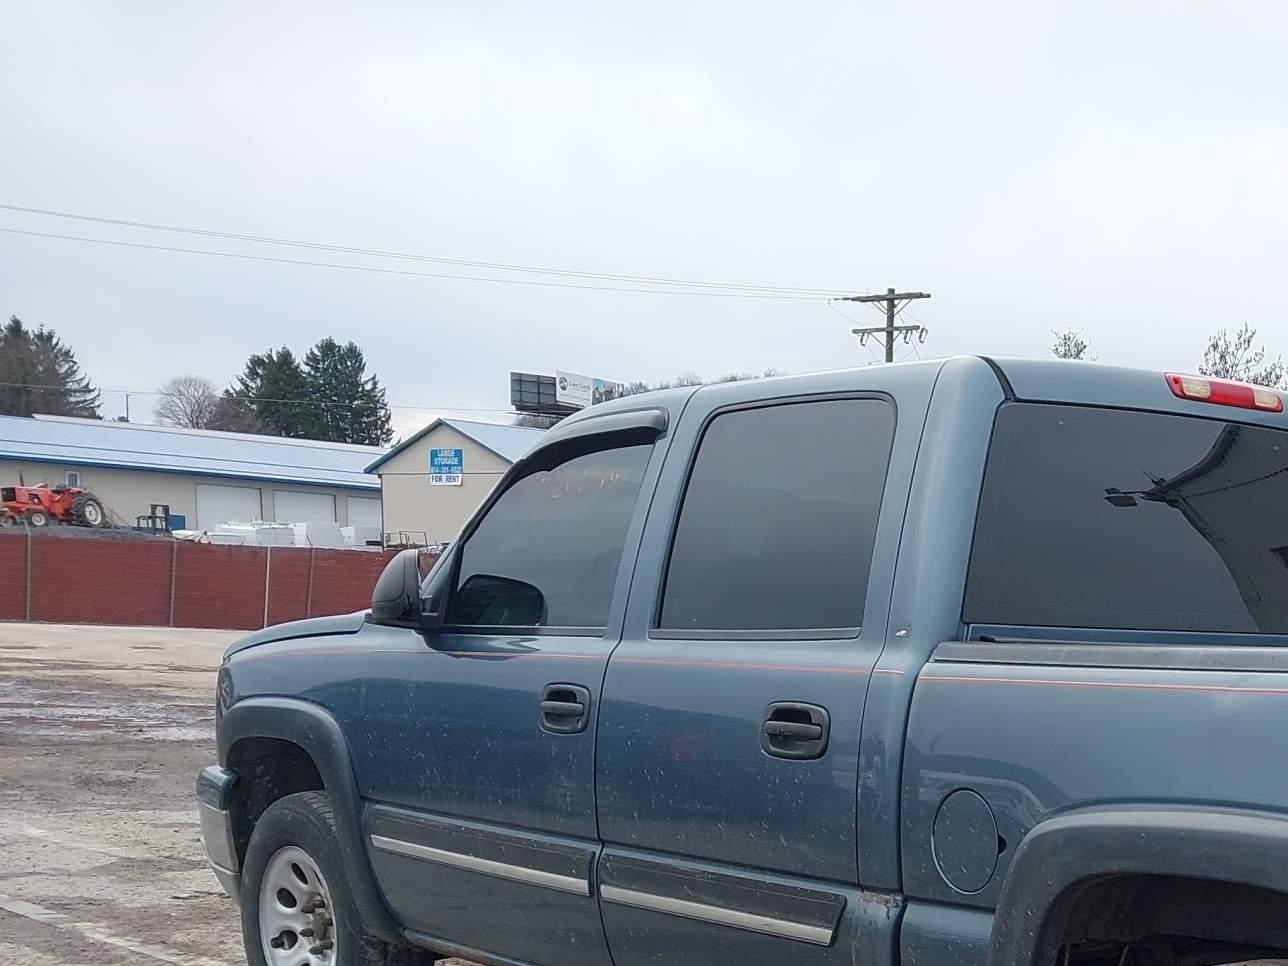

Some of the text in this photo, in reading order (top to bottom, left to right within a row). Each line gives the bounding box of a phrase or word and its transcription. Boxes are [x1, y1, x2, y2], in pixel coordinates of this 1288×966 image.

[437, 449, 455, 457] LARGE
[433, 457, 459, 465] STORAGE
[431, 475, 460, 483] FOR RENT
